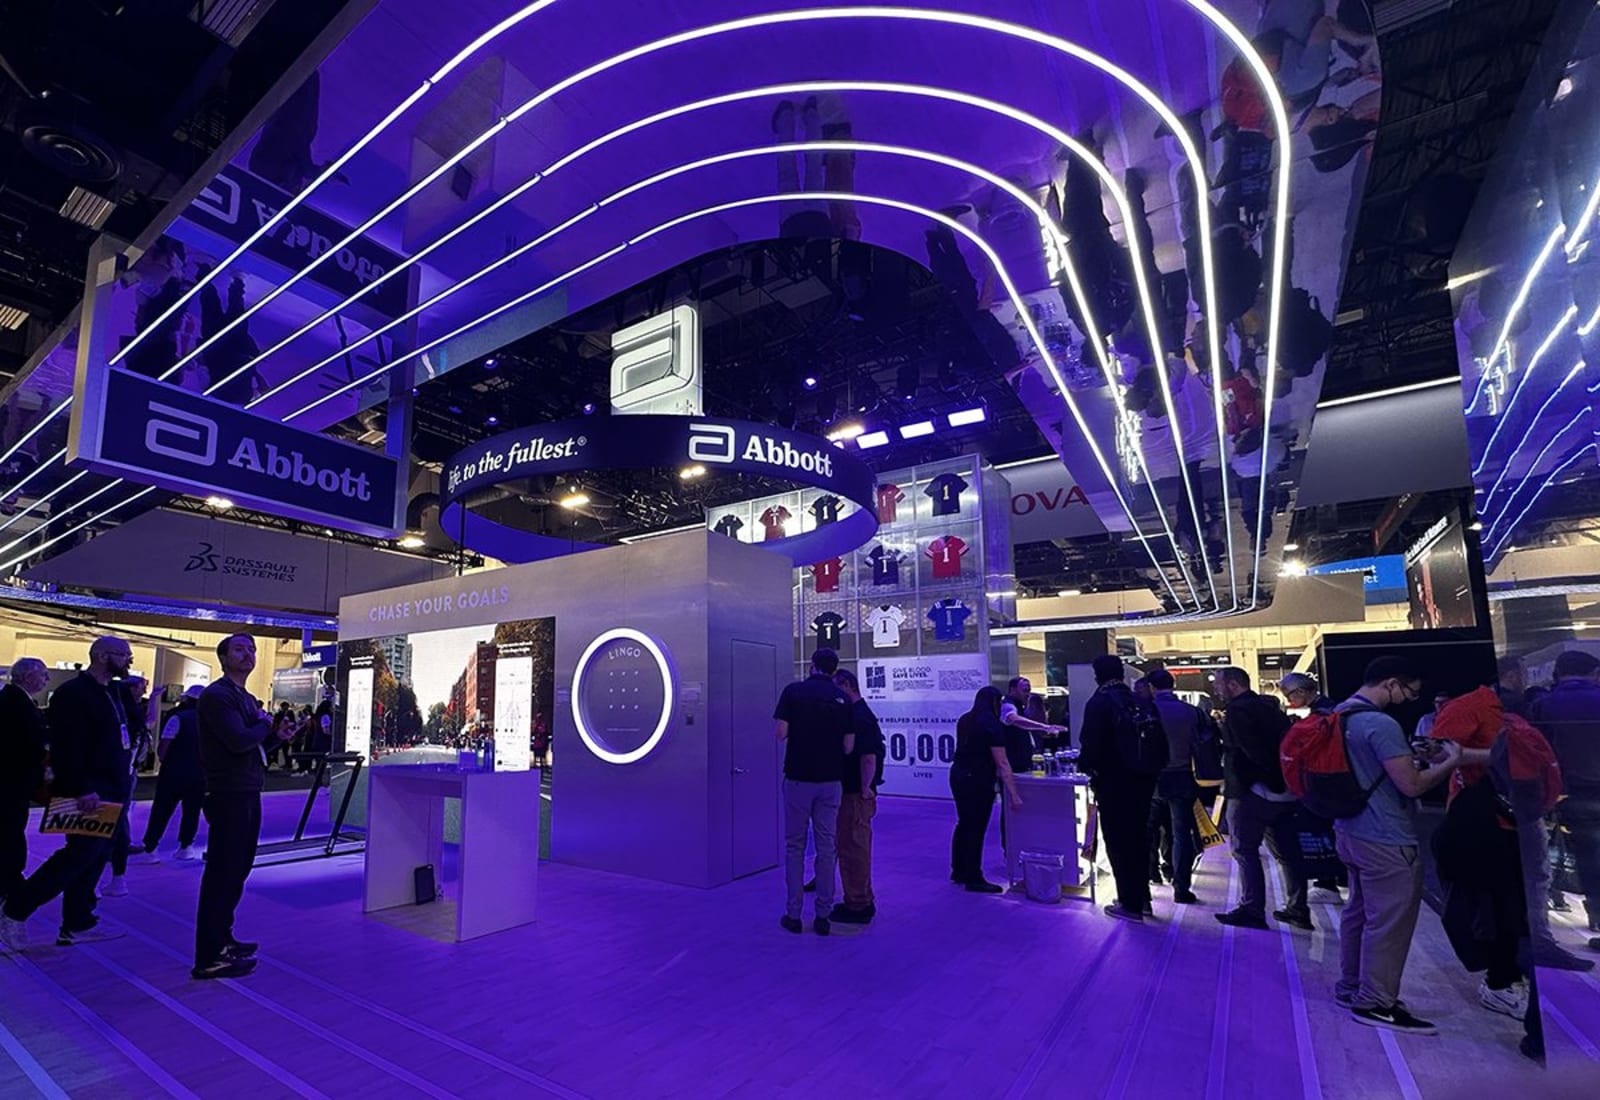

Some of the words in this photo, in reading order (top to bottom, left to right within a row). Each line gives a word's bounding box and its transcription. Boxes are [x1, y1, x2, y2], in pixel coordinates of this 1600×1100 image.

[463, 463, 476, 481] to
[478, 450, 504, 475] the
[742, 434, 833, 478] Abbott
[227, 436, 371, 501] Abbott
[943, 484, 950, 500] 1
[1011, 485, 1089, 515] OVA
[224, 556, 298, 573] DASSAULT
[943, 547, 949, 563] 1
[368, 602, 410, 622] CHASE
[414, 595, 453, 616] YOUR
[457, 584, 509, 609] GOALS
[608, 647, 641, 660] LINGO
[913, 771, 933, 779] LIVES
[46, 813, 115, 835] Nikon
